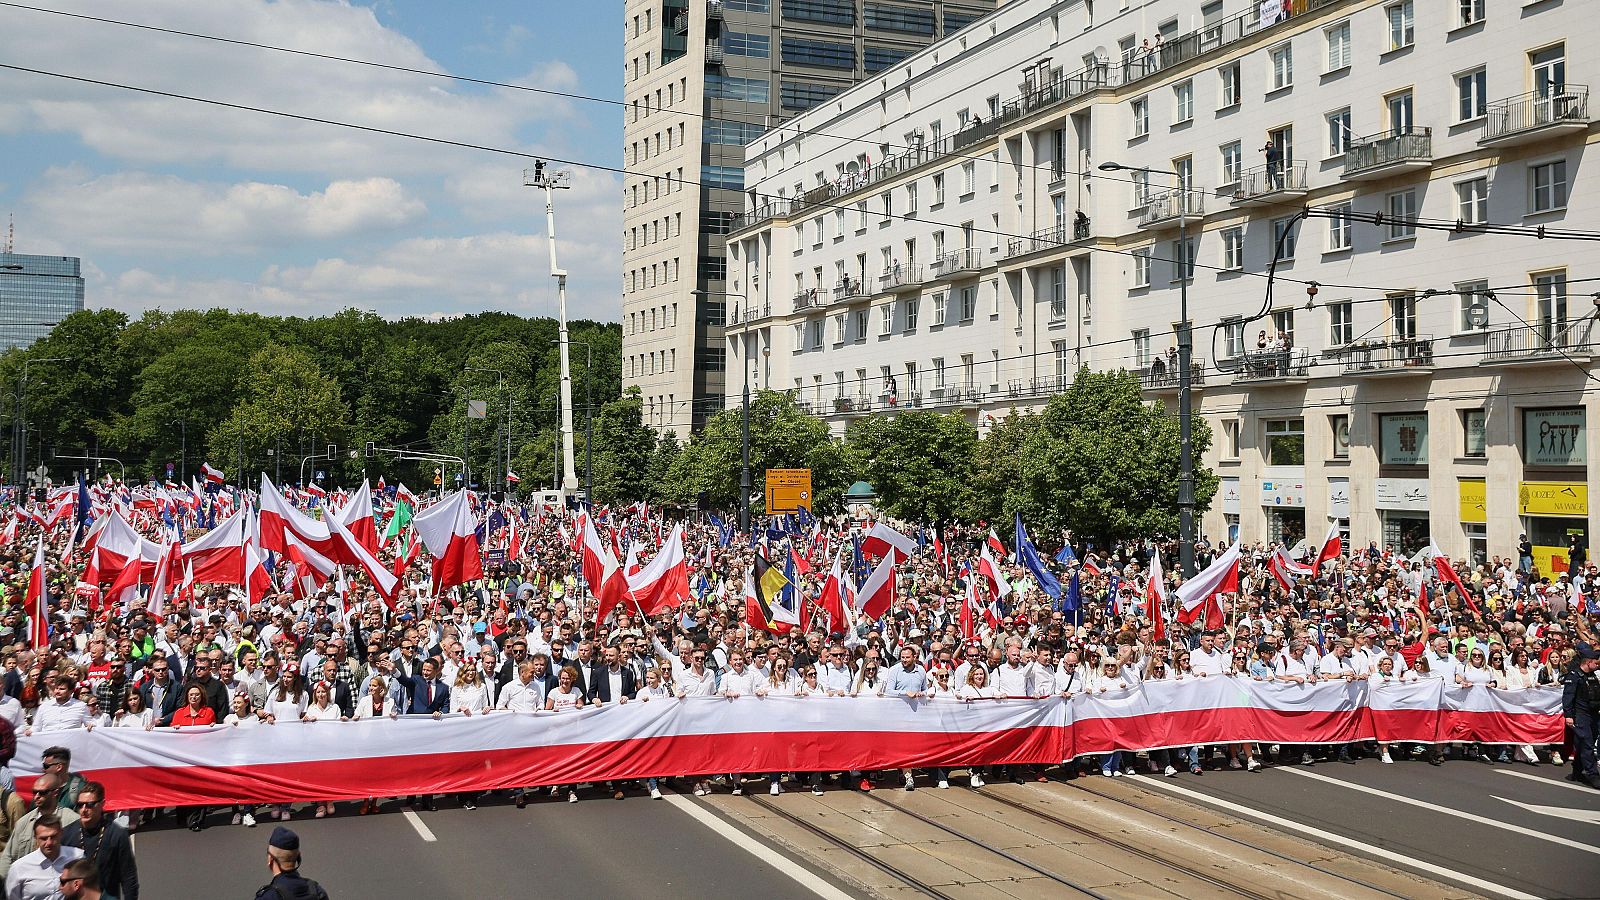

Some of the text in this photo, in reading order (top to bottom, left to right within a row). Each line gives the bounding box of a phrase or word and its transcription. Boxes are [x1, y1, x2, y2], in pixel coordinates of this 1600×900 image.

[1531, 489, 1556, 499] ODZIEŻ
[1554, 502, 1564, 511] NA
[1105, 578, 1118, 614] RAFAŁ
